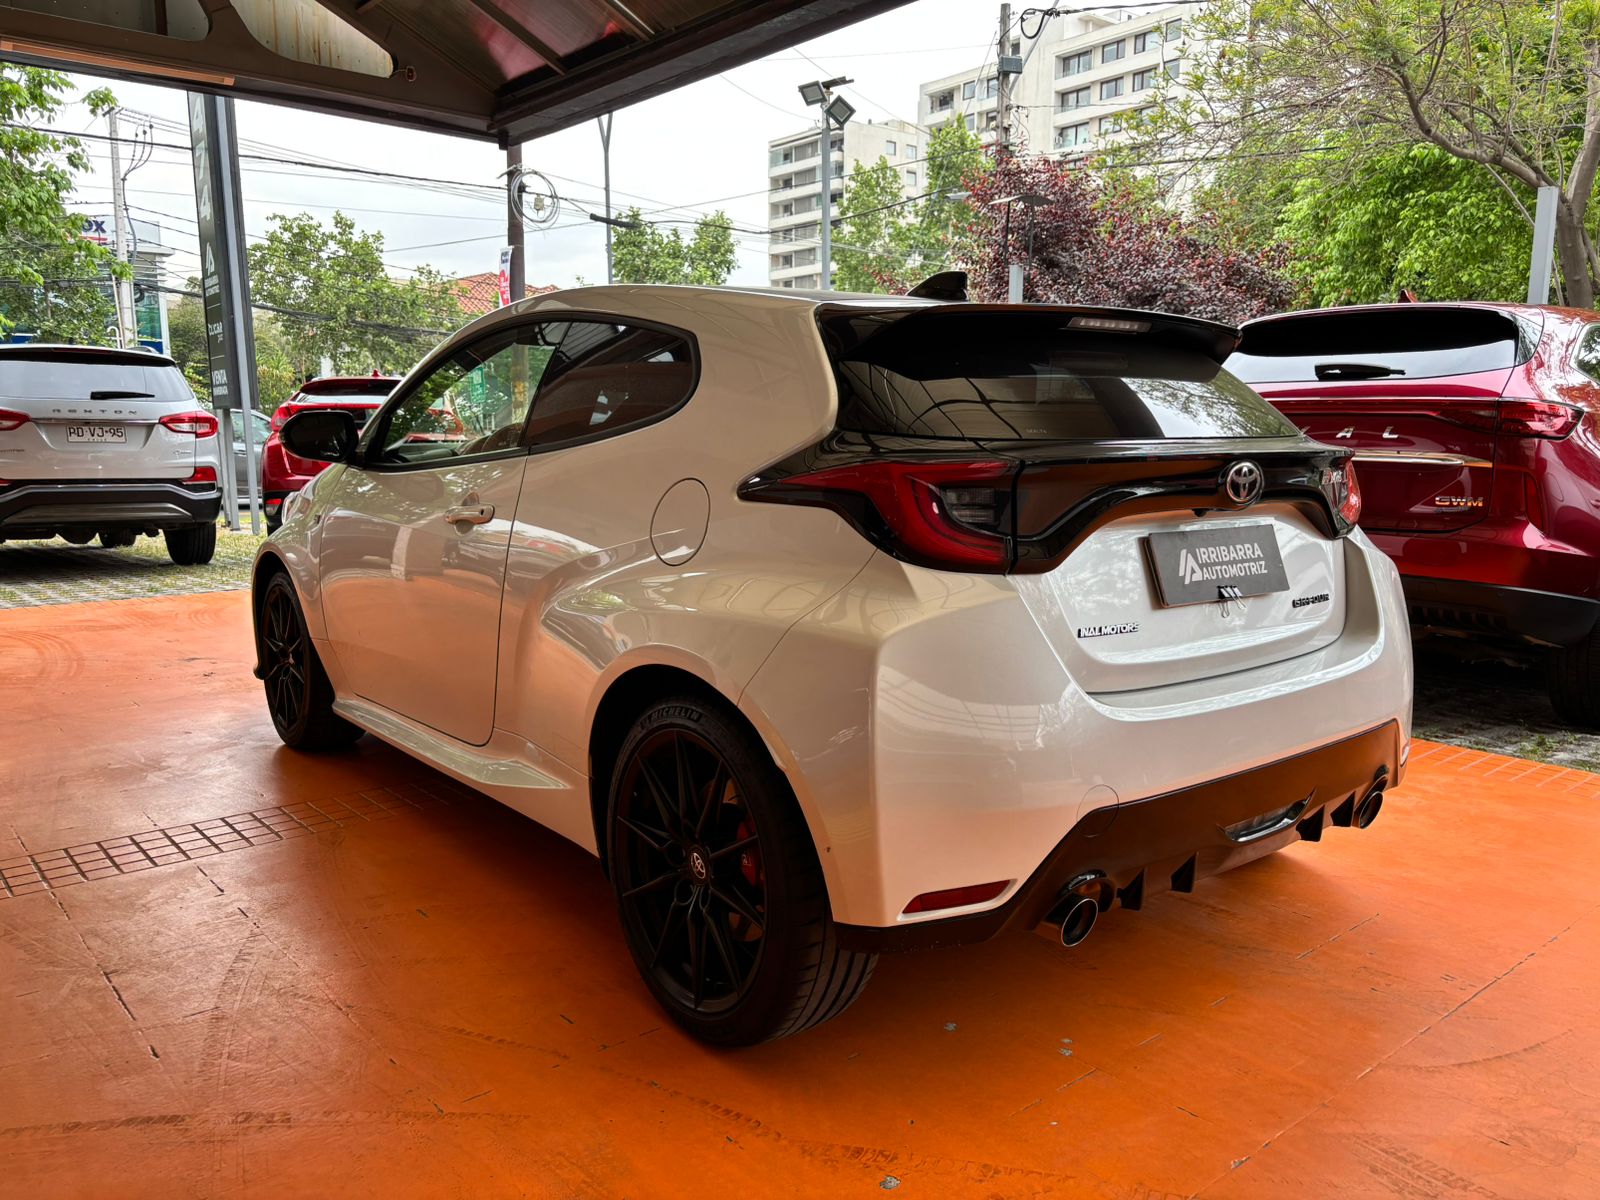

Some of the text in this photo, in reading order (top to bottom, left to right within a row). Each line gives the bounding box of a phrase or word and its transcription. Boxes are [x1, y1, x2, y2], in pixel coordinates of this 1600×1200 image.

[1435, 496, 1483, 506] GWM
[1196, 543, 1264, 564] IRRIBARRA
[1203, 561, 1268, 581] AUTOMOTRIZ
[1101, 622, 1140, 636] MOTORS
